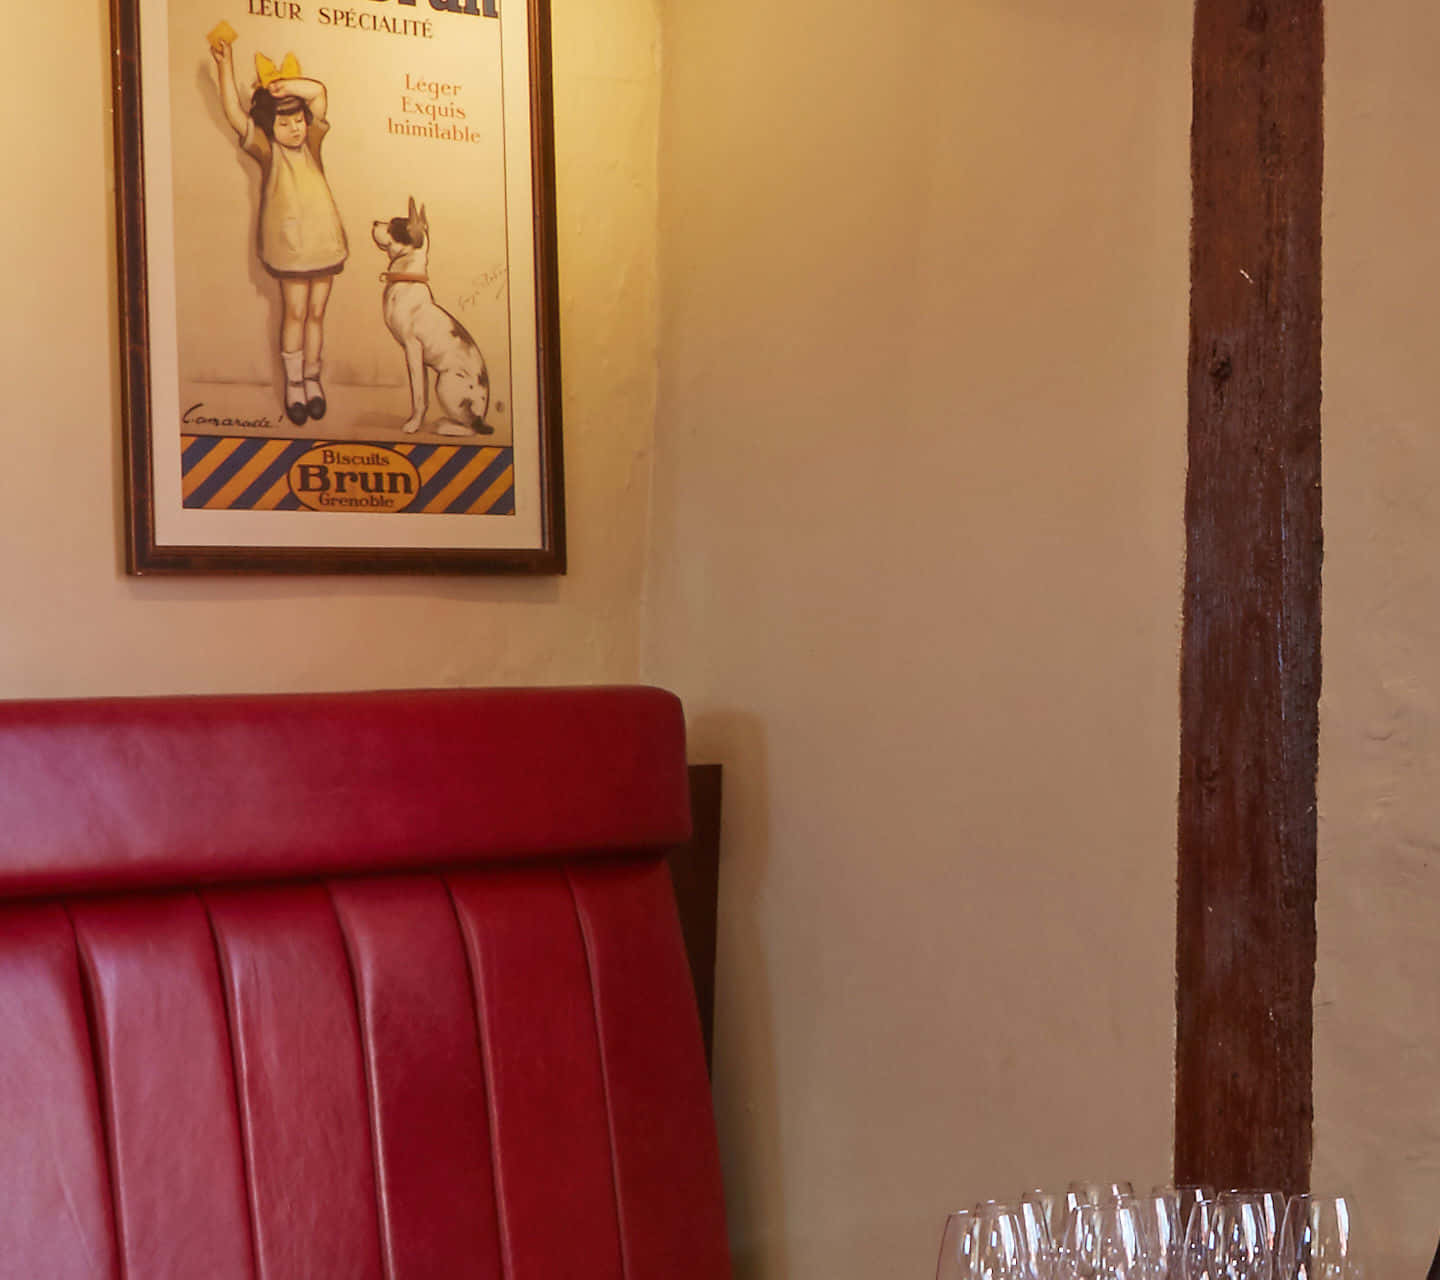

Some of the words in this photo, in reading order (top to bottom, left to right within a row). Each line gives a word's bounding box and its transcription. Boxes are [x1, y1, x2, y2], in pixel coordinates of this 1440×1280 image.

[318, 6, 434, 39] SPÉCIALITÉ
[401, 95, 467, 120] Exquis
[387, 116, 482, 145] Inimitable
[322, 449, 390, 467] Biscuits
[297, 463, 414, 495] Brun
[318, 491, 395, 508] Grenoble
